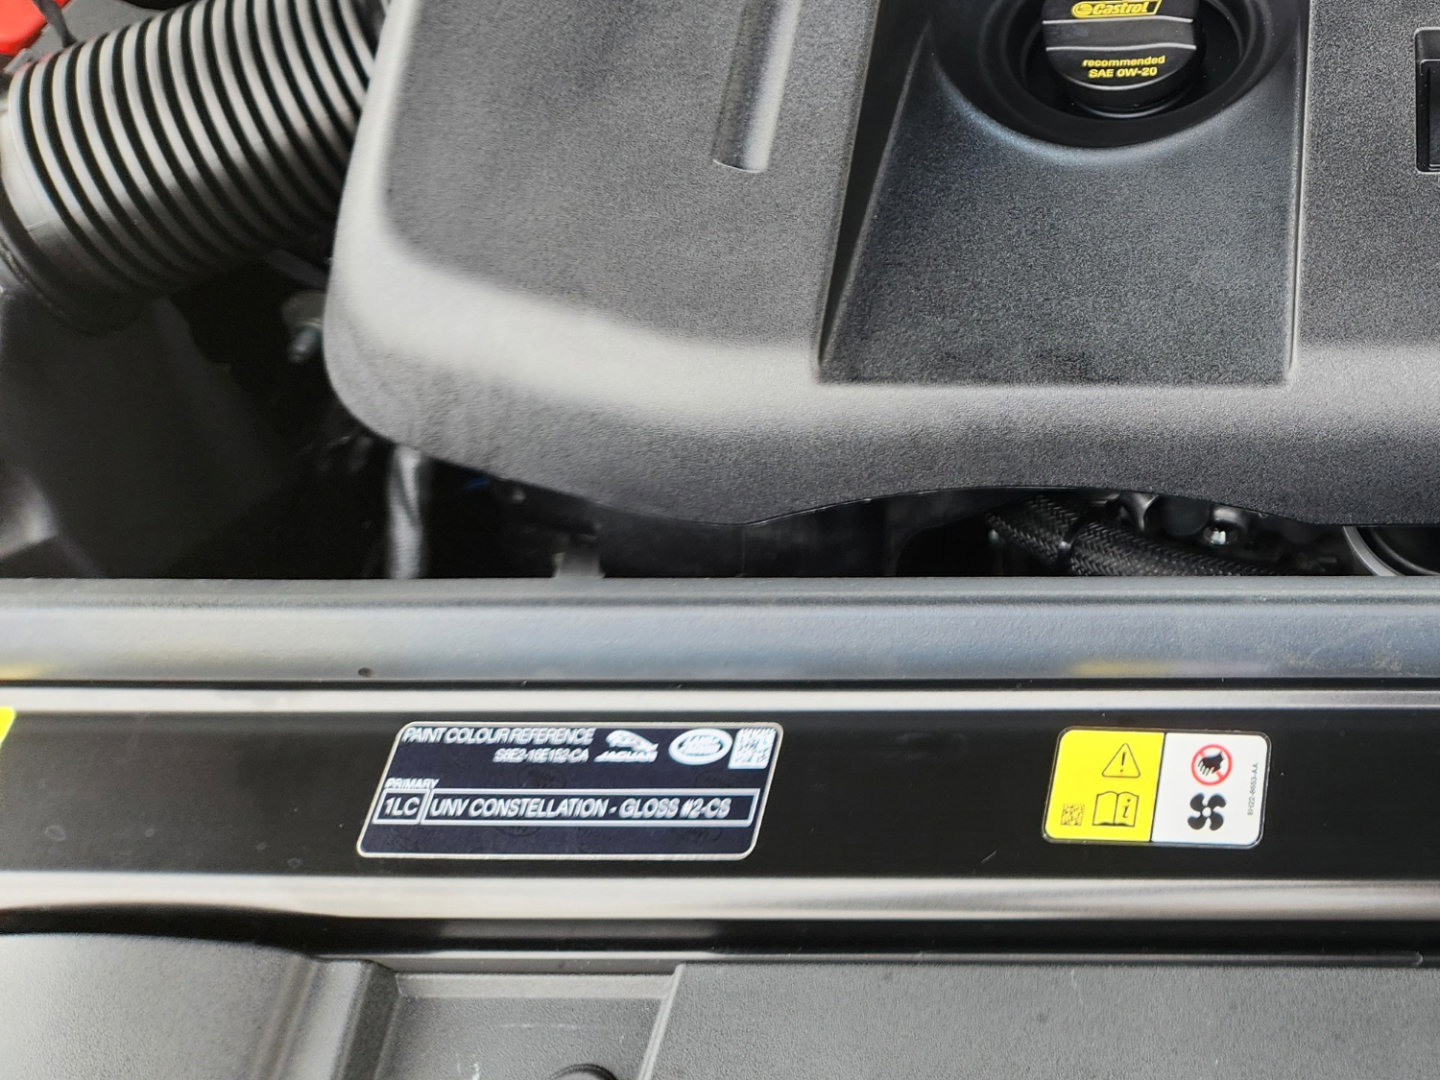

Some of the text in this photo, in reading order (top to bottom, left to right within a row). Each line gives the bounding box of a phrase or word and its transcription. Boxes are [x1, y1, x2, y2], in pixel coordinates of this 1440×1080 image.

[1093, 1, 1149, 15] Castrol
[1082, 55, 1166, 67] recommended
[1089, 66, 1158, 78] SAE 0W-20
[401, 727, 598, 745] PAINT COLOUR REFERENCE
[384, 778, 440, 789] PRIMARY
[382, 798, 420, 816] 1LC
[430, 798, 468, 817] UNV
[470, 798, 607, 818] CONSTELLATION
[619, 797, 680, 818] GLOSS
